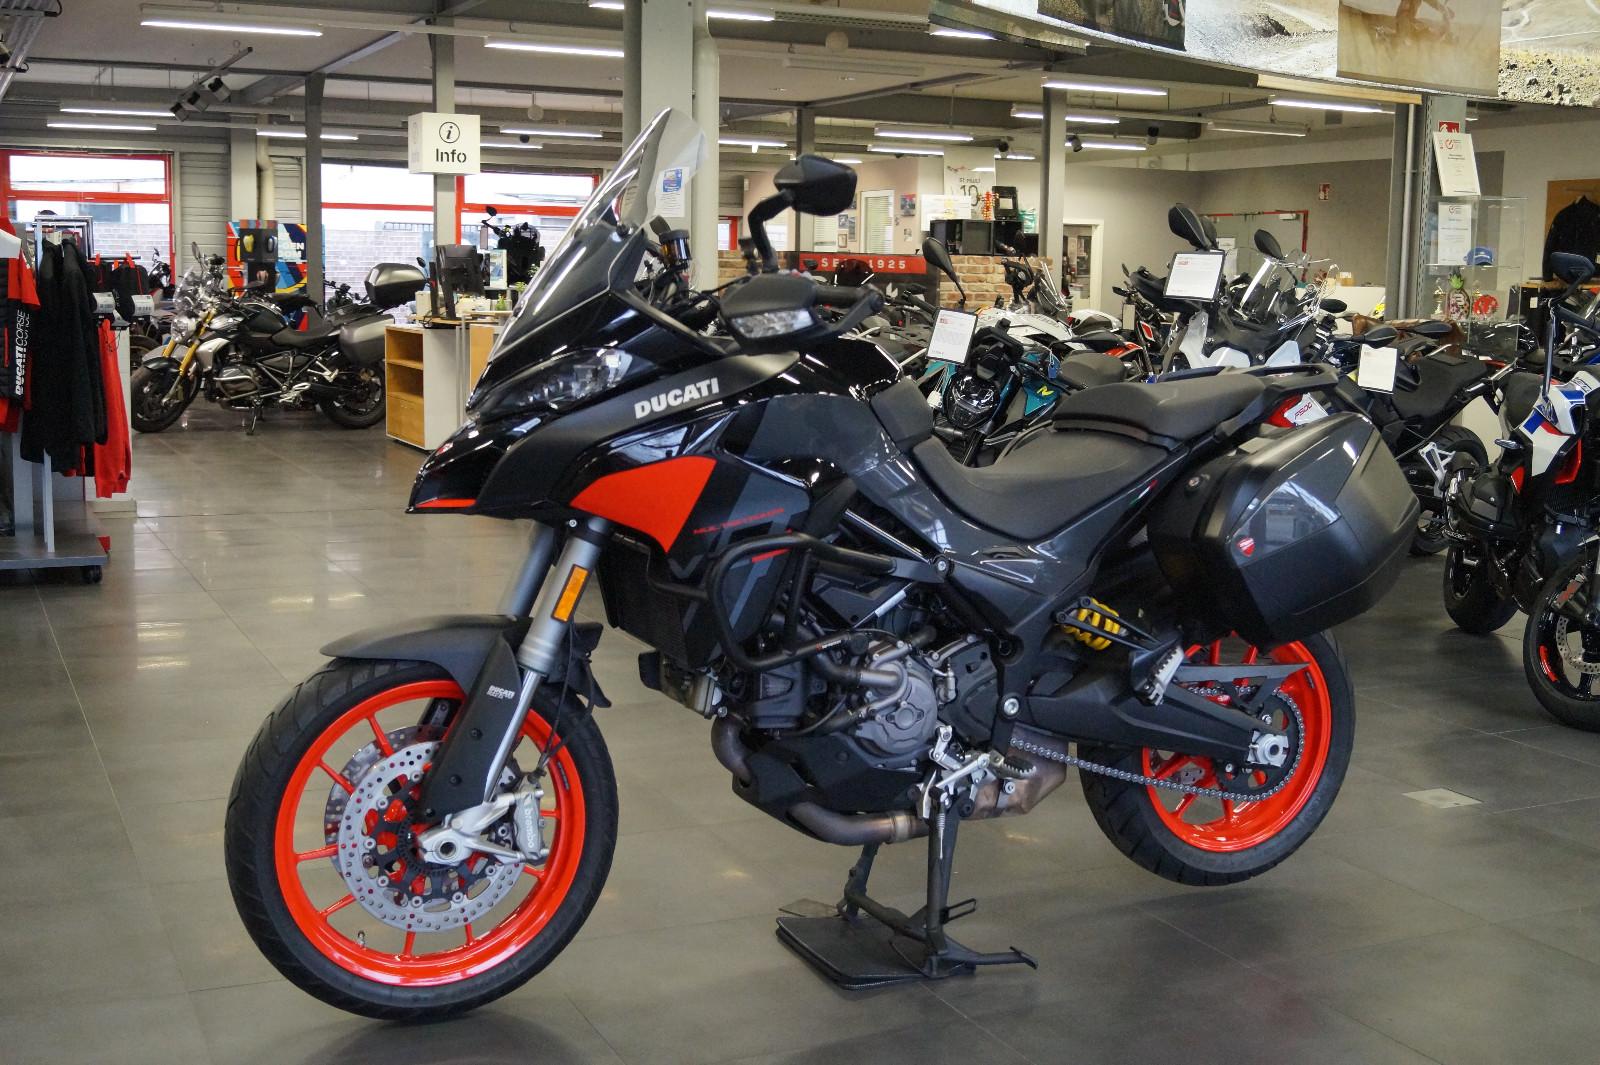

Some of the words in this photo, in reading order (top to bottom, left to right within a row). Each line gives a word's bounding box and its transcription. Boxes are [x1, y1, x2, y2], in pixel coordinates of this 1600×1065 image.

[435, 148, 467, 163] Info
[868, 259, 906, 270] 1925
[15, 309, 26, 346] CORSE
[15, 345, 25, 396] DUCATI
[633, 377, 720, 419] DUCATI
[524, 808, 535, 849] brembo
